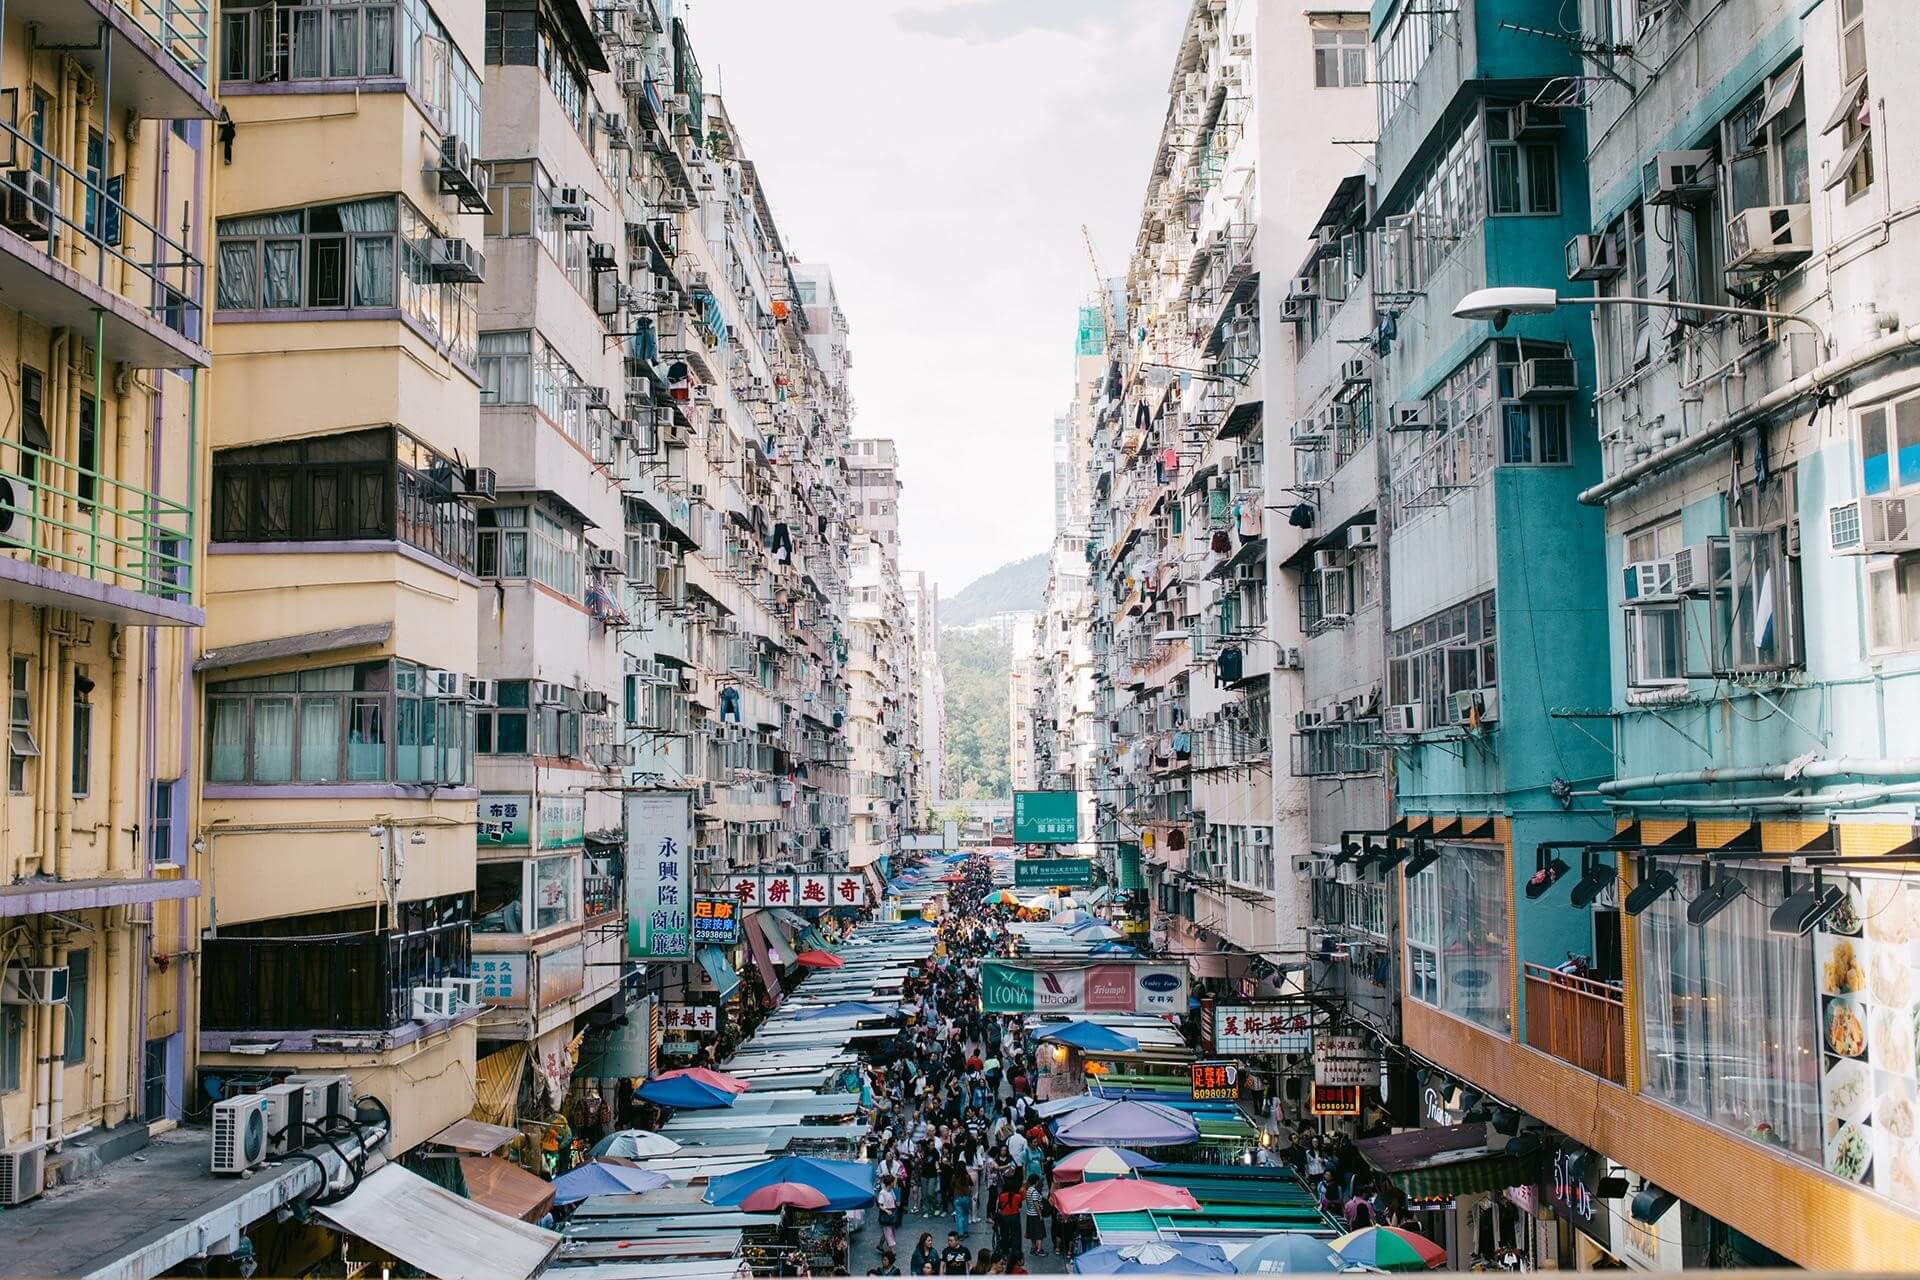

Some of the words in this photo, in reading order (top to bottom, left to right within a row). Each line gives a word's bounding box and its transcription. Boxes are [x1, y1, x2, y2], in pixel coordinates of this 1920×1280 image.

[658, 836, 679, 906] 永興隆
[472, 974, 512, 985] 公道
[1094, 984, 1126, 996] Triumph
[1040, 994, 1078, 1005] Wacoal
